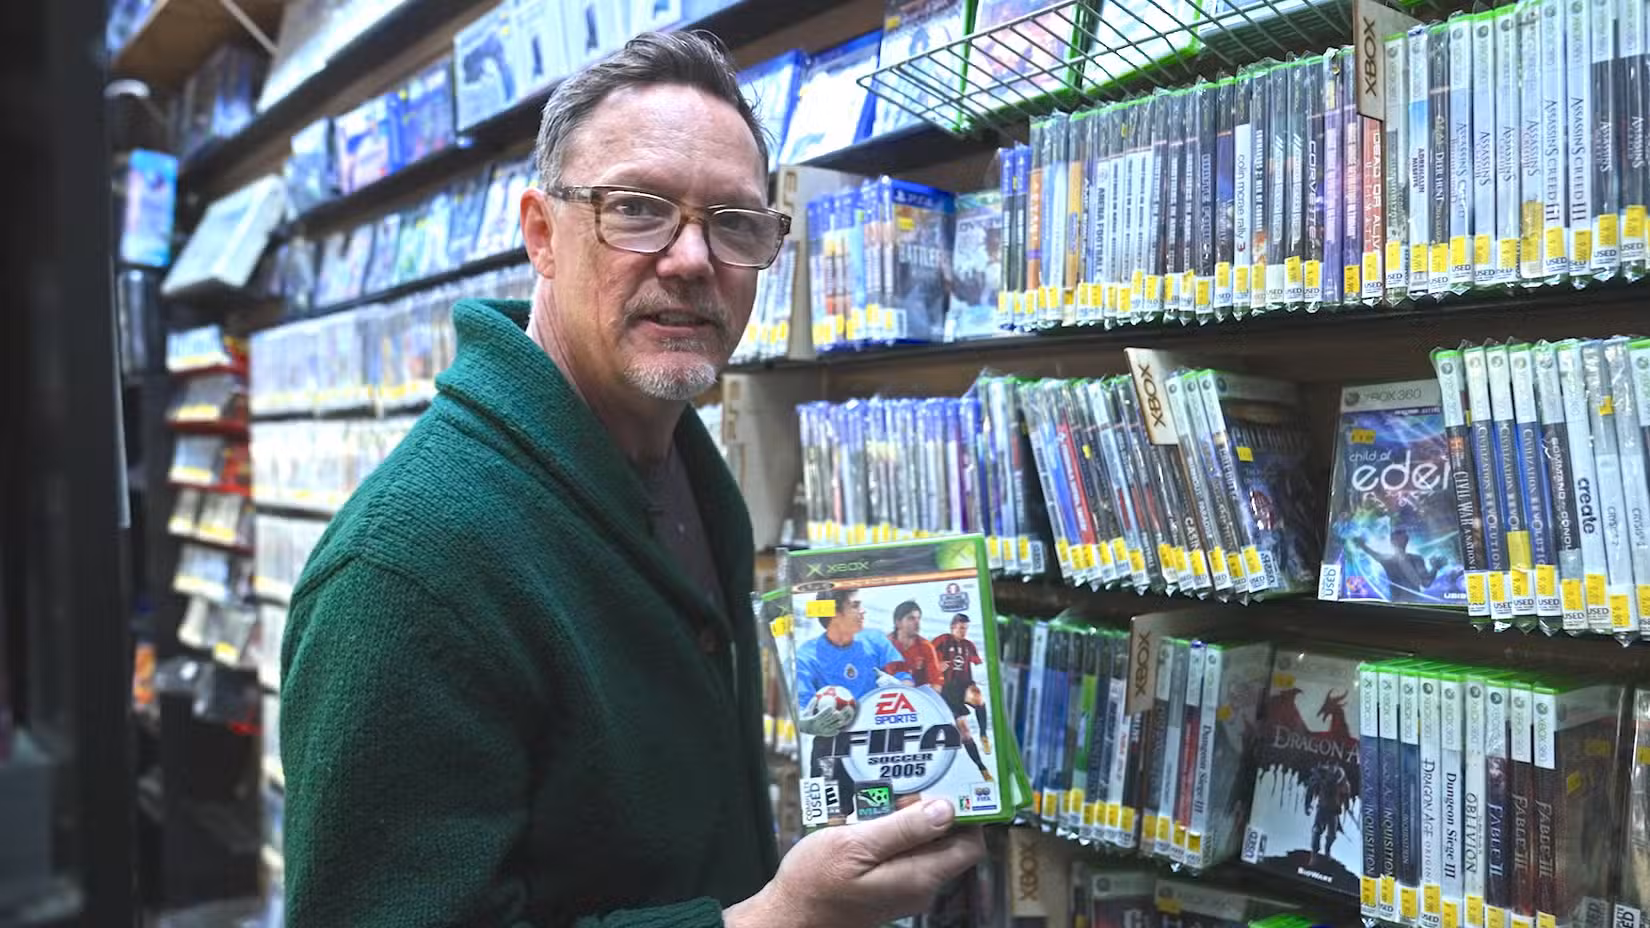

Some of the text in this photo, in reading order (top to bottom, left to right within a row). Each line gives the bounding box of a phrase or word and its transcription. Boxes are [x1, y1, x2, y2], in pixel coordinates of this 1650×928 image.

[1363, 18, 1377, 97] XBOX
[1237, 153, 1247, 180] colin
[1372, 132, 1381, 178] DEAD
[1308, 140, 1317, 240] CORVETTE
[1547, 158, 1557, 201] CREED
[1573, 156, 1584, 200] CREED
[1097, 187, 1106, 222] ARENA
[1237, 182, 1245, 215] mcrae
[1571, 201, 1587, 222] III
[1236, 218, 1246, 239] rally
[1451, 264, 1471, 272] USED
[1474, 269, 1495, 277] USED
[1138, 363, 1166, 429] XBOX
[1398, 387, 1422, 401] 360
[1348, 450, 1377, 463] child
[1501, 427, 1515, 491] CIVILIZATION
[1523, 428, 1538, 495] CIVILIZATION
[1551, 437, 1566, 499] COMMAND
[1452, 470, 1469, 499] CIVIL
[1478, 426, 1502, 570] CIVILIZATION REVOLUTION
[1456, 501, 1474, 526] WAR
[1577, 476, 1598, 535] create
[827, 560, 870, 574] XBOX
[1513, 598, 1534, 607] USED
[1538, 598, 1560, 606] USED
[1586, 608, 1609, 616] USED
[1134, 631, 1151, 698] XBOX
[875, 692, 916, 715] EA
[875, 713, 918, 725] SPORTS
[835, 723, 962, 758] FIFA
[1272, 725, 1344, 759] DRAGON
[868, 753, 933, 765] SOCCER
[879, 763, 926, 778] 2005
[812, 782, 822, 818] USED
[1422, 758, 1435, 811] DRAGON
[1364, 803, 1377, 873] INQUISITION
[1384, 807, 1394, 877] INQUISITION
[1402, 814, 1410, 864] INQUISITION
[1423, 812, 1435, 838] AGE
[1444, 772, 1458, 880] Dungeon Siege III
[1465, 792, 1477, 873] OBLIVION
[1488, 803, 1504, 878] FABLE II
[1511, 793, 1528, 872] FABLE III
[1535, 799, 1553, 878] FABLE III
[1018, 841, 1039, 901] XBOX
